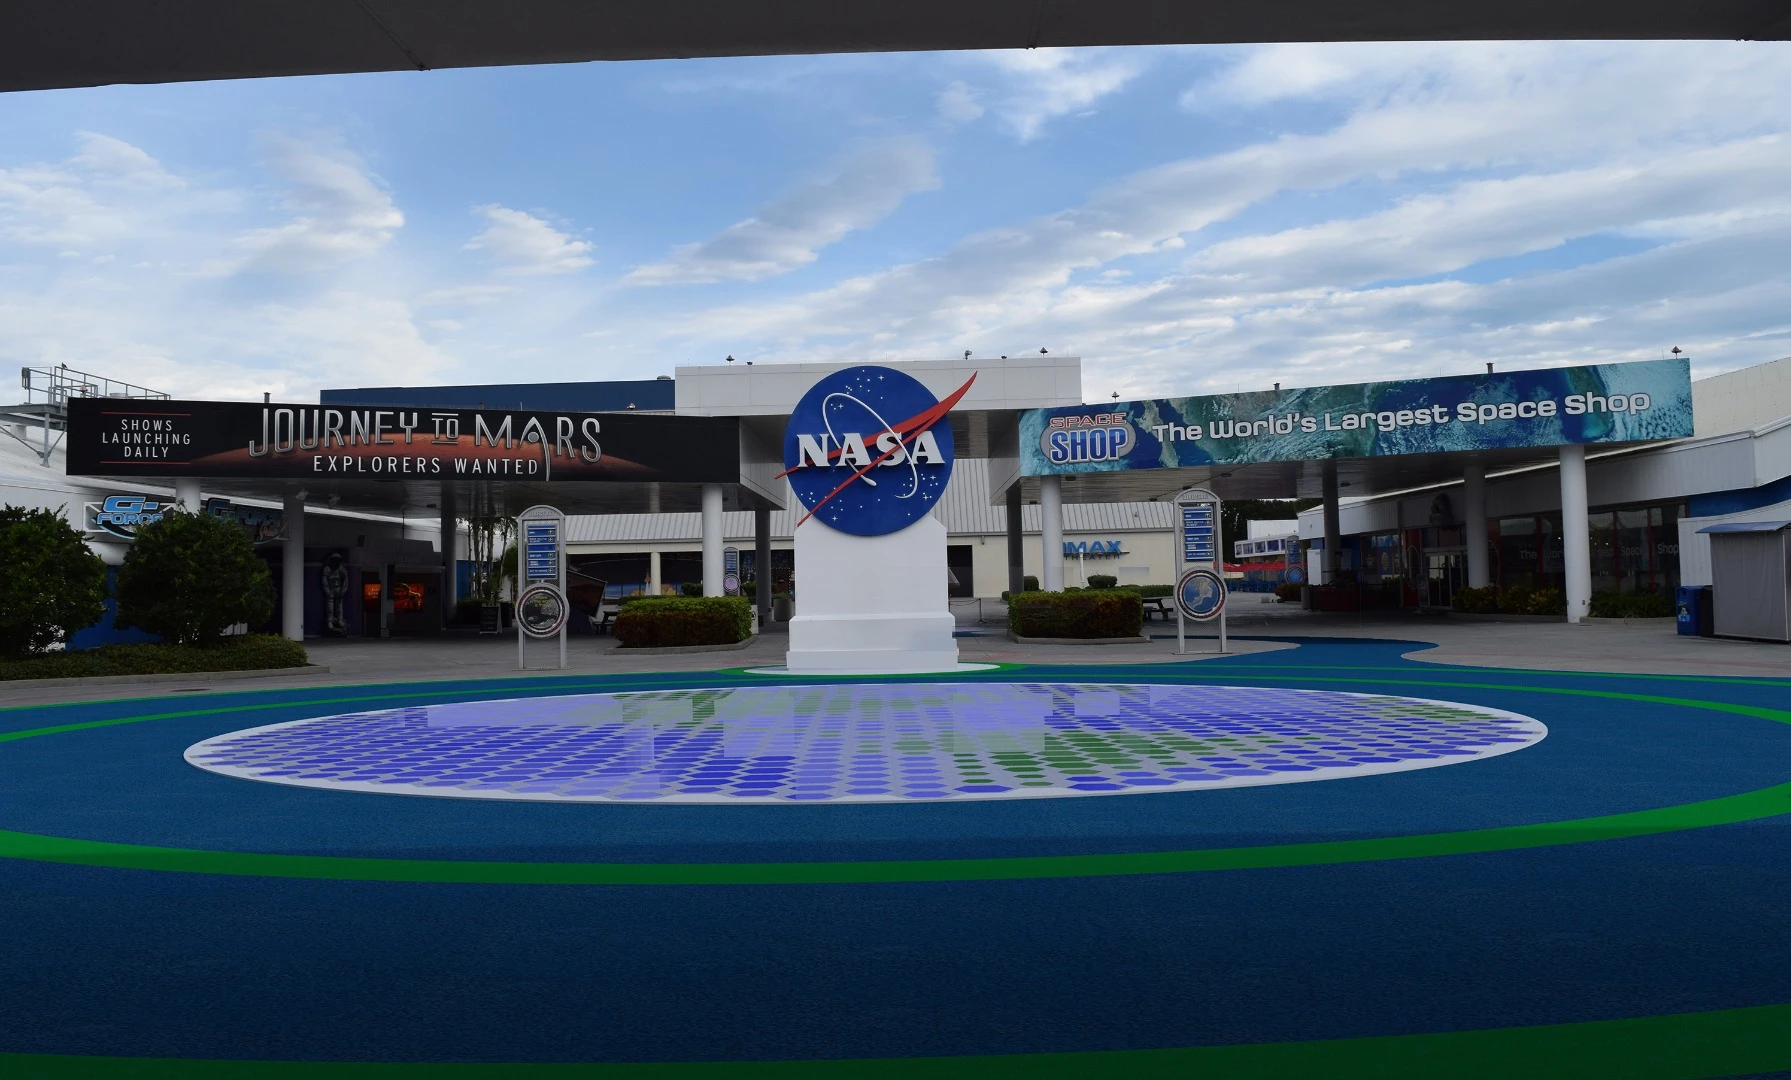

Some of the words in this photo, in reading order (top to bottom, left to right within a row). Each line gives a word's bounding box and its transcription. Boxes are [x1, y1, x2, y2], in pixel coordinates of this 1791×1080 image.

[121, 419, 173, 431] SHOWS
[1050, 412, 1127, 429] SPACE
[1152, 422, 1203, 443] The
[1209, 412, 1317, 440] World's
[1324, 404, 1449, 432] Largest
[1456, 399, 1557, 425] Space
[1564, 391, 1650, 415] Shop
[102, 432, 191, 445] LAUNCHING
[249, 408, 418, 457] JOURNEY
[431, 415, 459, 441] TO
[475, 414, 601, 482] MARS
[1050, 427, 1128, 463] SHOP
[124, 446, 169, 458] DAILY
[796, 430, 946, 468] NASA
[313, 455, 441, 474] EXPLORERS
[454, 457, 538, 475] WANTED
[1063, 541, 1121, 553] IMAX
